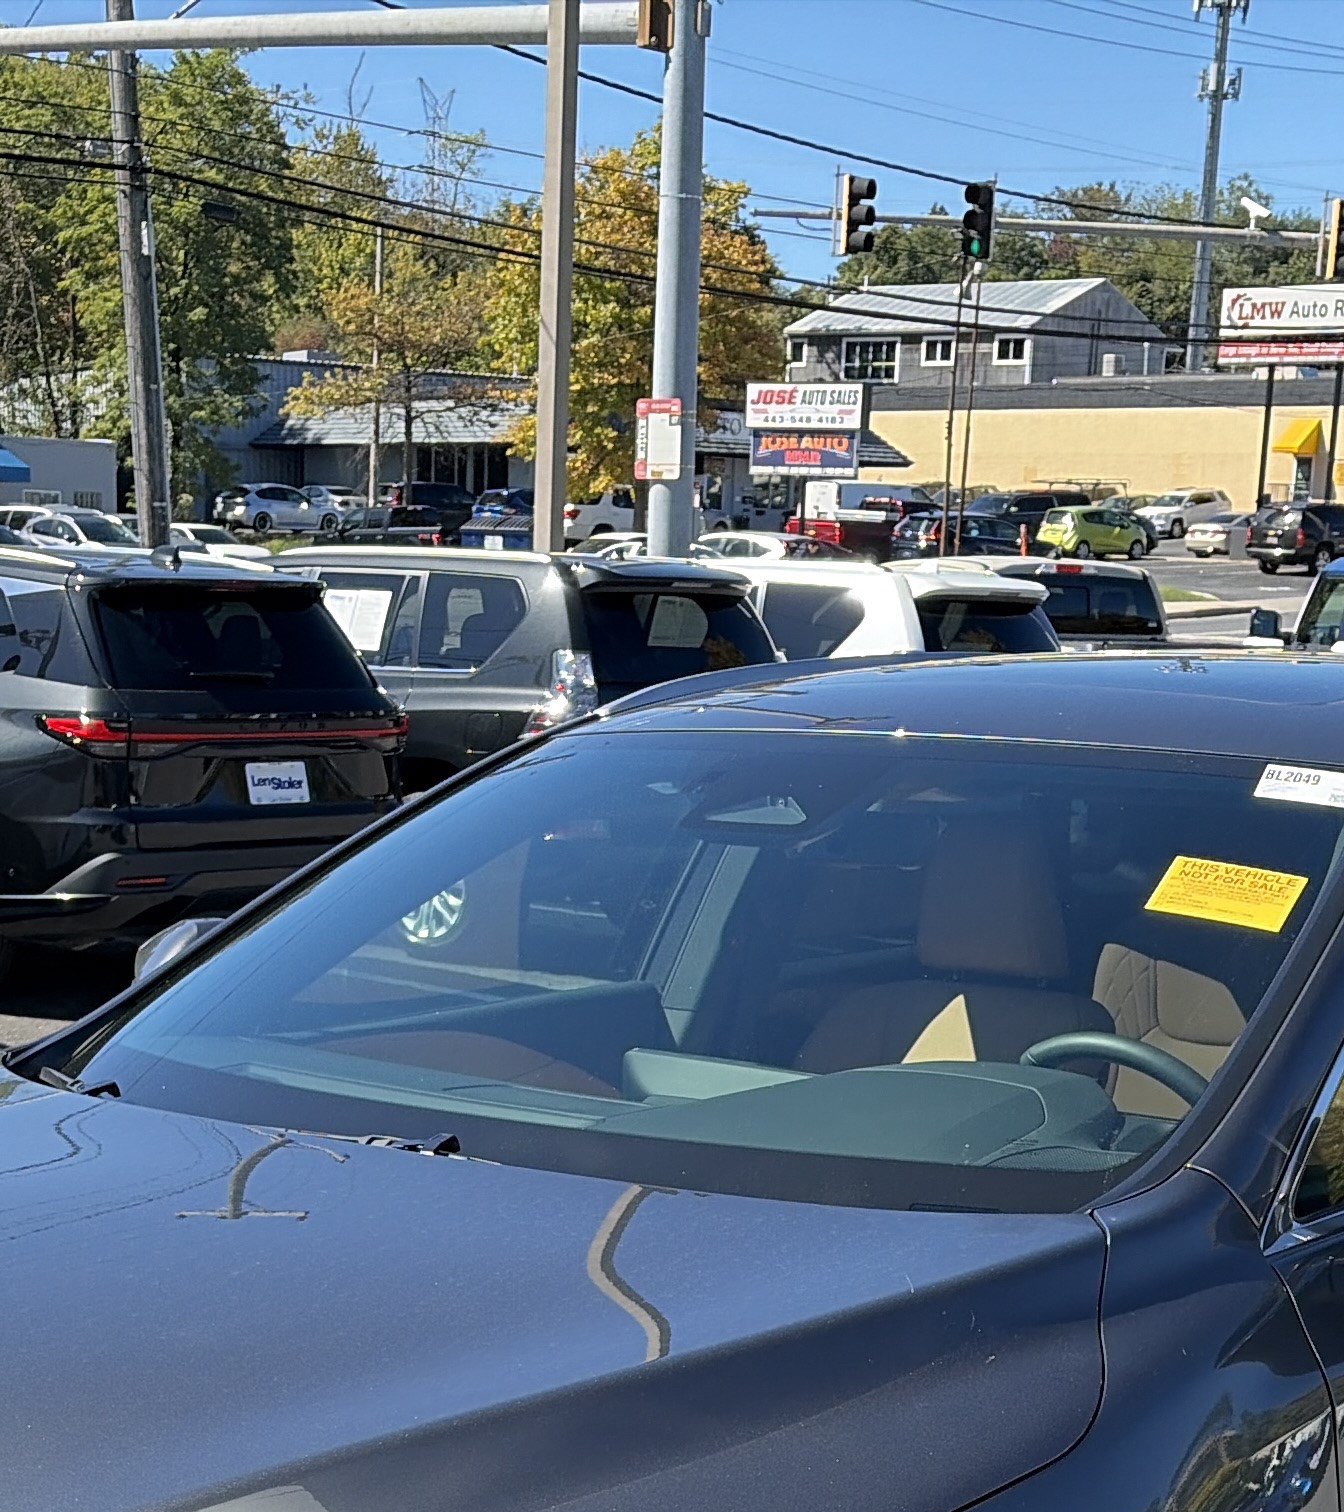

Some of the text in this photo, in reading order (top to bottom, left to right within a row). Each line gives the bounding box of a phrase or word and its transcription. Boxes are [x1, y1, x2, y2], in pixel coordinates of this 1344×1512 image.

[1237, 301, 1286, 320] LMW
[1289, 301, 1328, 318] Auto
[751, 385, 859, 405] JOSÉ AUTO SALES
[800, 435, 849, 453] AUTO
[1265, 769, 1321, 786] BL2049
[1178, 870, 1289, 894] NOT FOR SALE
[1181, 861, 1300, 888] THIS VEHICLE
